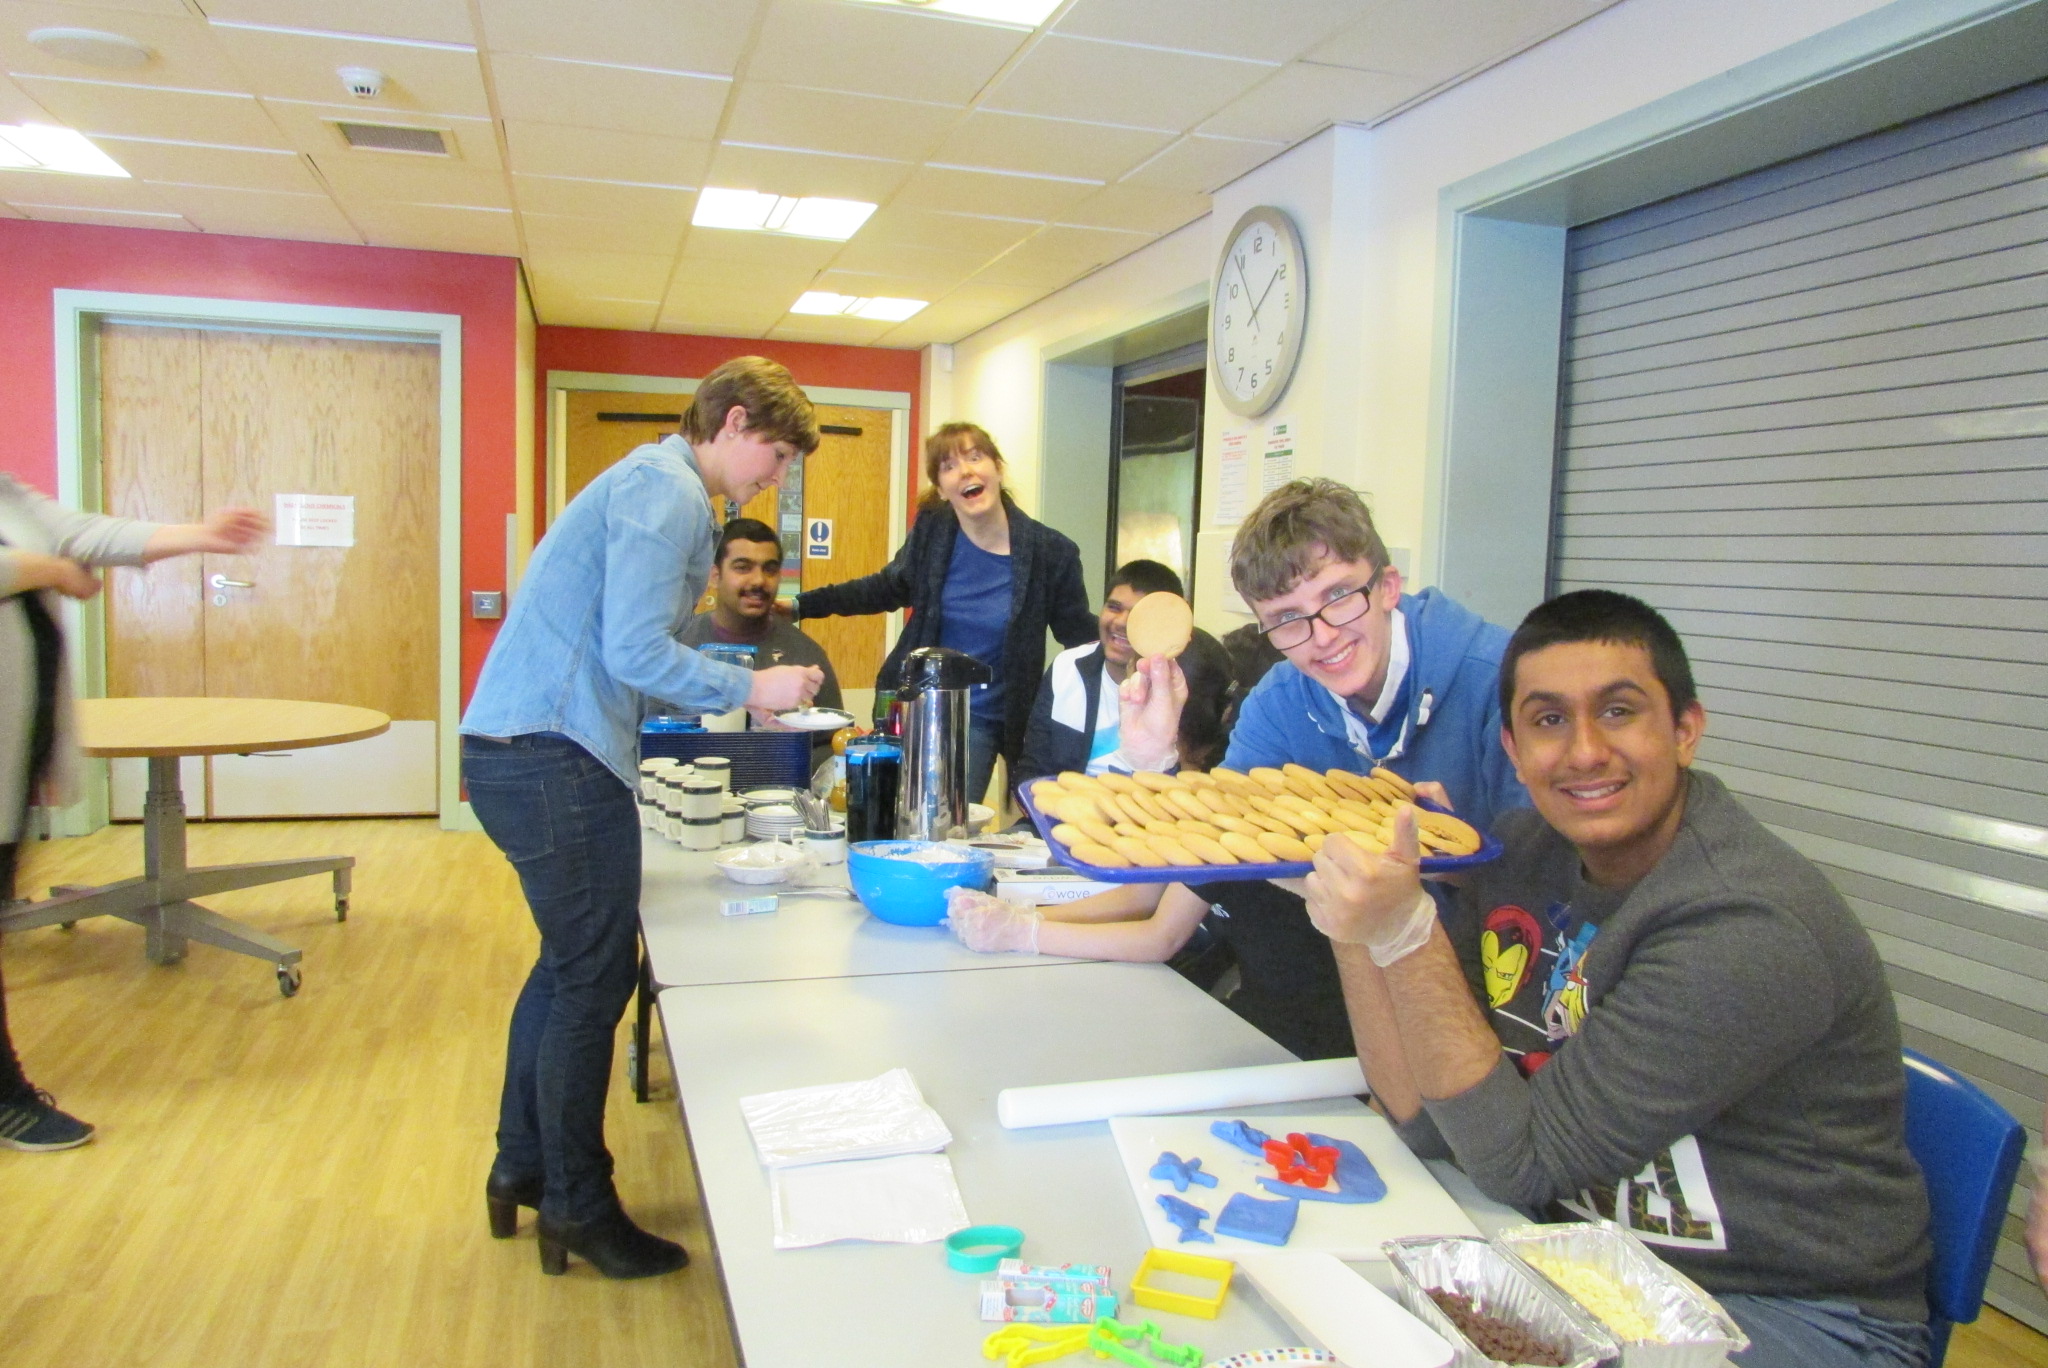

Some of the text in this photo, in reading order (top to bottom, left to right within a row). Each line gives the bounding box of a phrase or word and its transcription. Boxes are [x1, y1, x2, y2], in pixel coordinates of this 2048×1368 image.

[1253, 237, 1263, 253] 12
[1279, 264, 1287, 280] 2
[1229, 284, 1239, 300] 10
[1225, 315, 1232, 330] 9
[1277, 332, 1284, 346] 4
[1228, 347, 1235, 363] 8
[1238, 367, 1244, 383] 7
[1264, 359, 1272, 376] 5
[1250, 373, 1257, 389] 6
